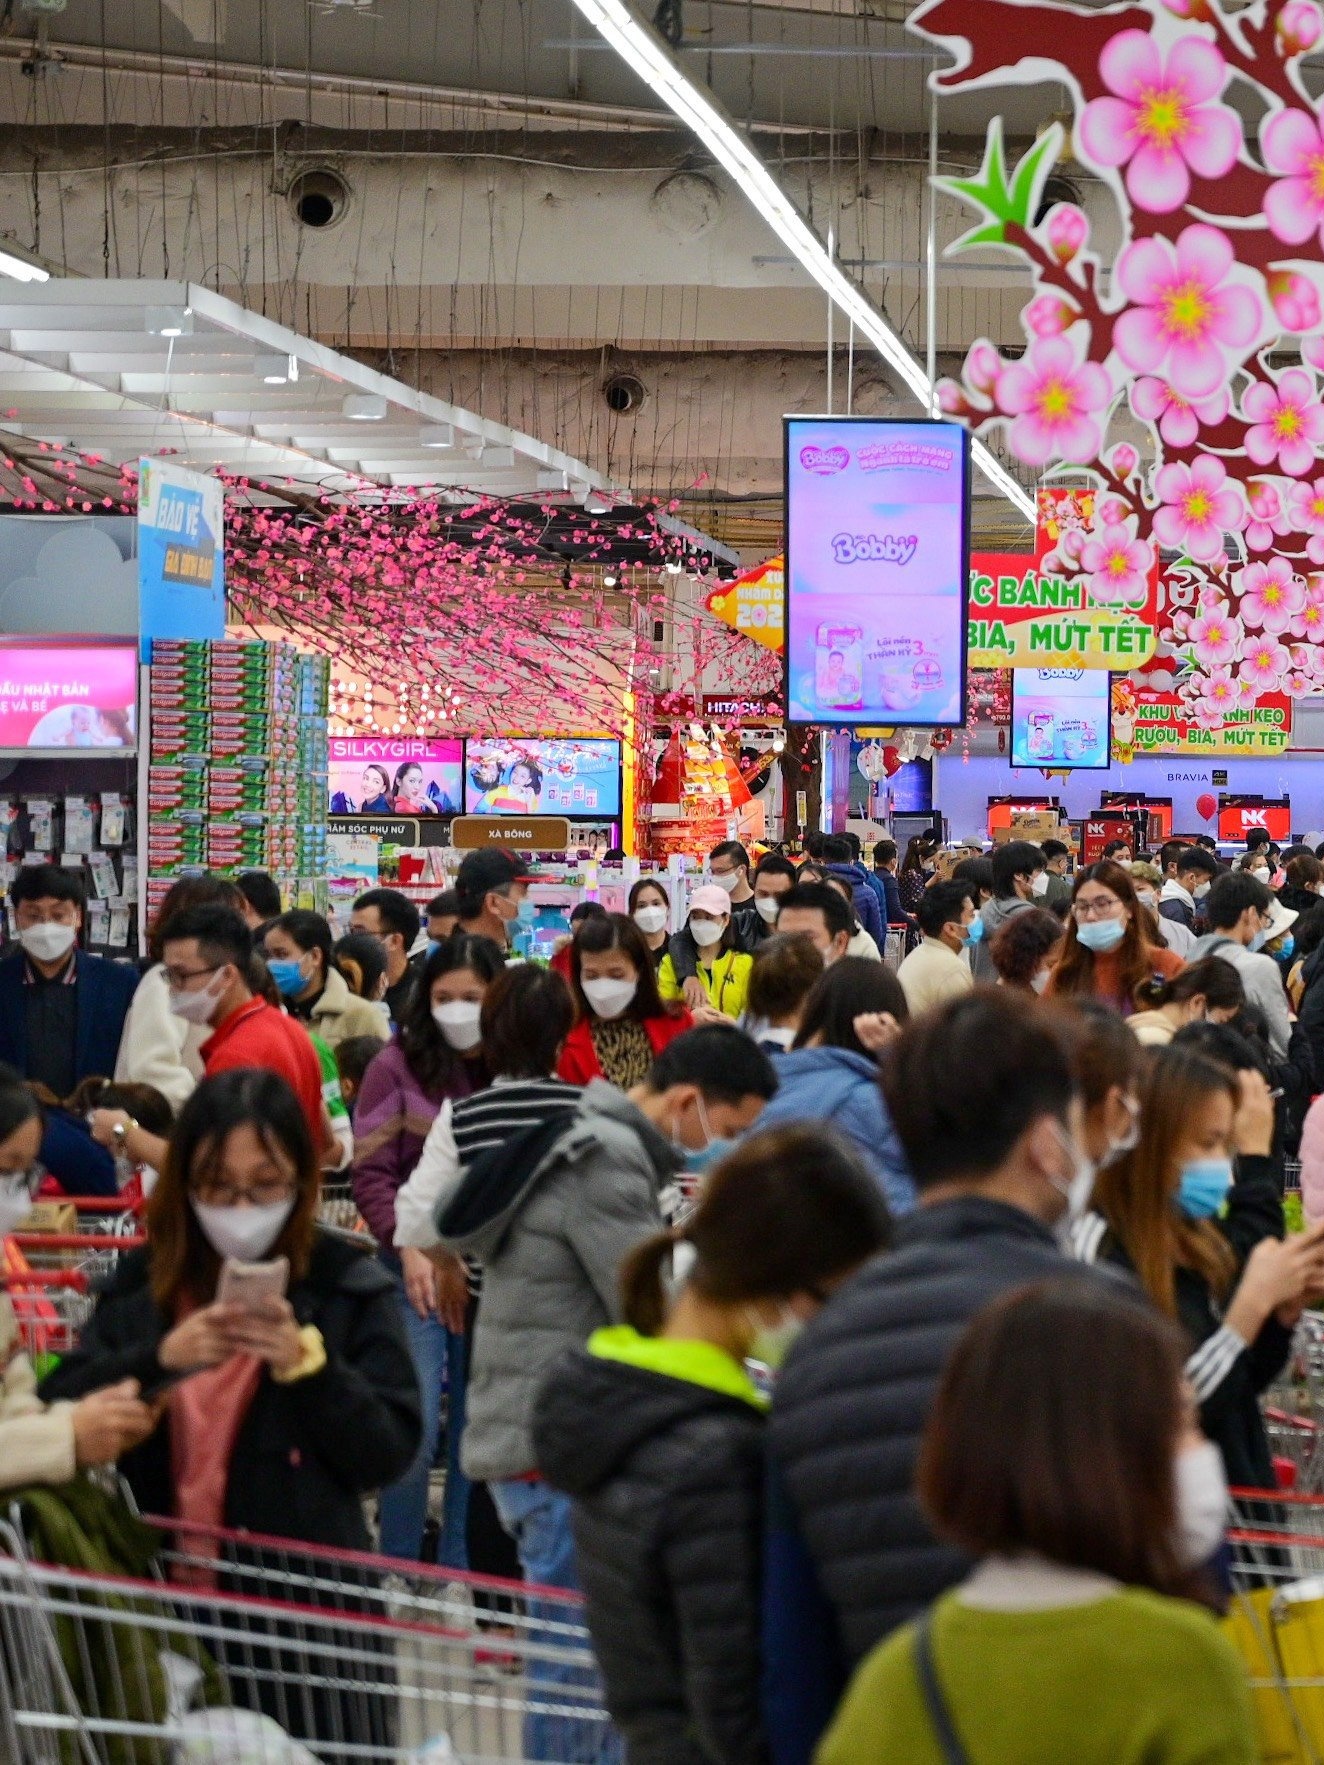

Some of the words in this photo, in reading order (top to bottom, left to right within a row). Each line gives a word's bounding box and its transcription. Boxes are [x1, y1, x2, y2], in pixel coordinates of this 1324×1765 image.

[803, 450, 847, 467] Bobby
[832, 533, 917, 565] Bobby
[737, 586, 771, 600] NHÂM
[999, 571, 1081, 607] BÁNH
[877, 637, 892, 647] Lõi
[1030, 617, 1092, 652] MỨT
[1098, 616, 1153, 653] TẾT
[913, 640, 924, 656] 3
[23, 682, 60, 696] NHẬT
[62, 680, 90, 697] BẢN
[1139, 705, 1171, 719] KHU
[1254, 708, 1285, 728] KẸO
[1135, 726, 1180, 746] RƯỢU,
[1187, 729, 1217, 746] BIA,
[1224, 727, 1255, 745] MỨT
[1259, 726, 1287, 746] TẾT
[333, 741, 437, 757] SILKYGIRL
[1241, 809, 1267, 827] NK
[348, 823, 367, 834] SÓC
[370, 824, 388, 838] PHỤ
[391, 824, 406, 835] NỮ
[489, 827, 502, 839] XÀ
[504, 828, 533, 840] BÔNG
[1087, 823, 1105, 834] NK
